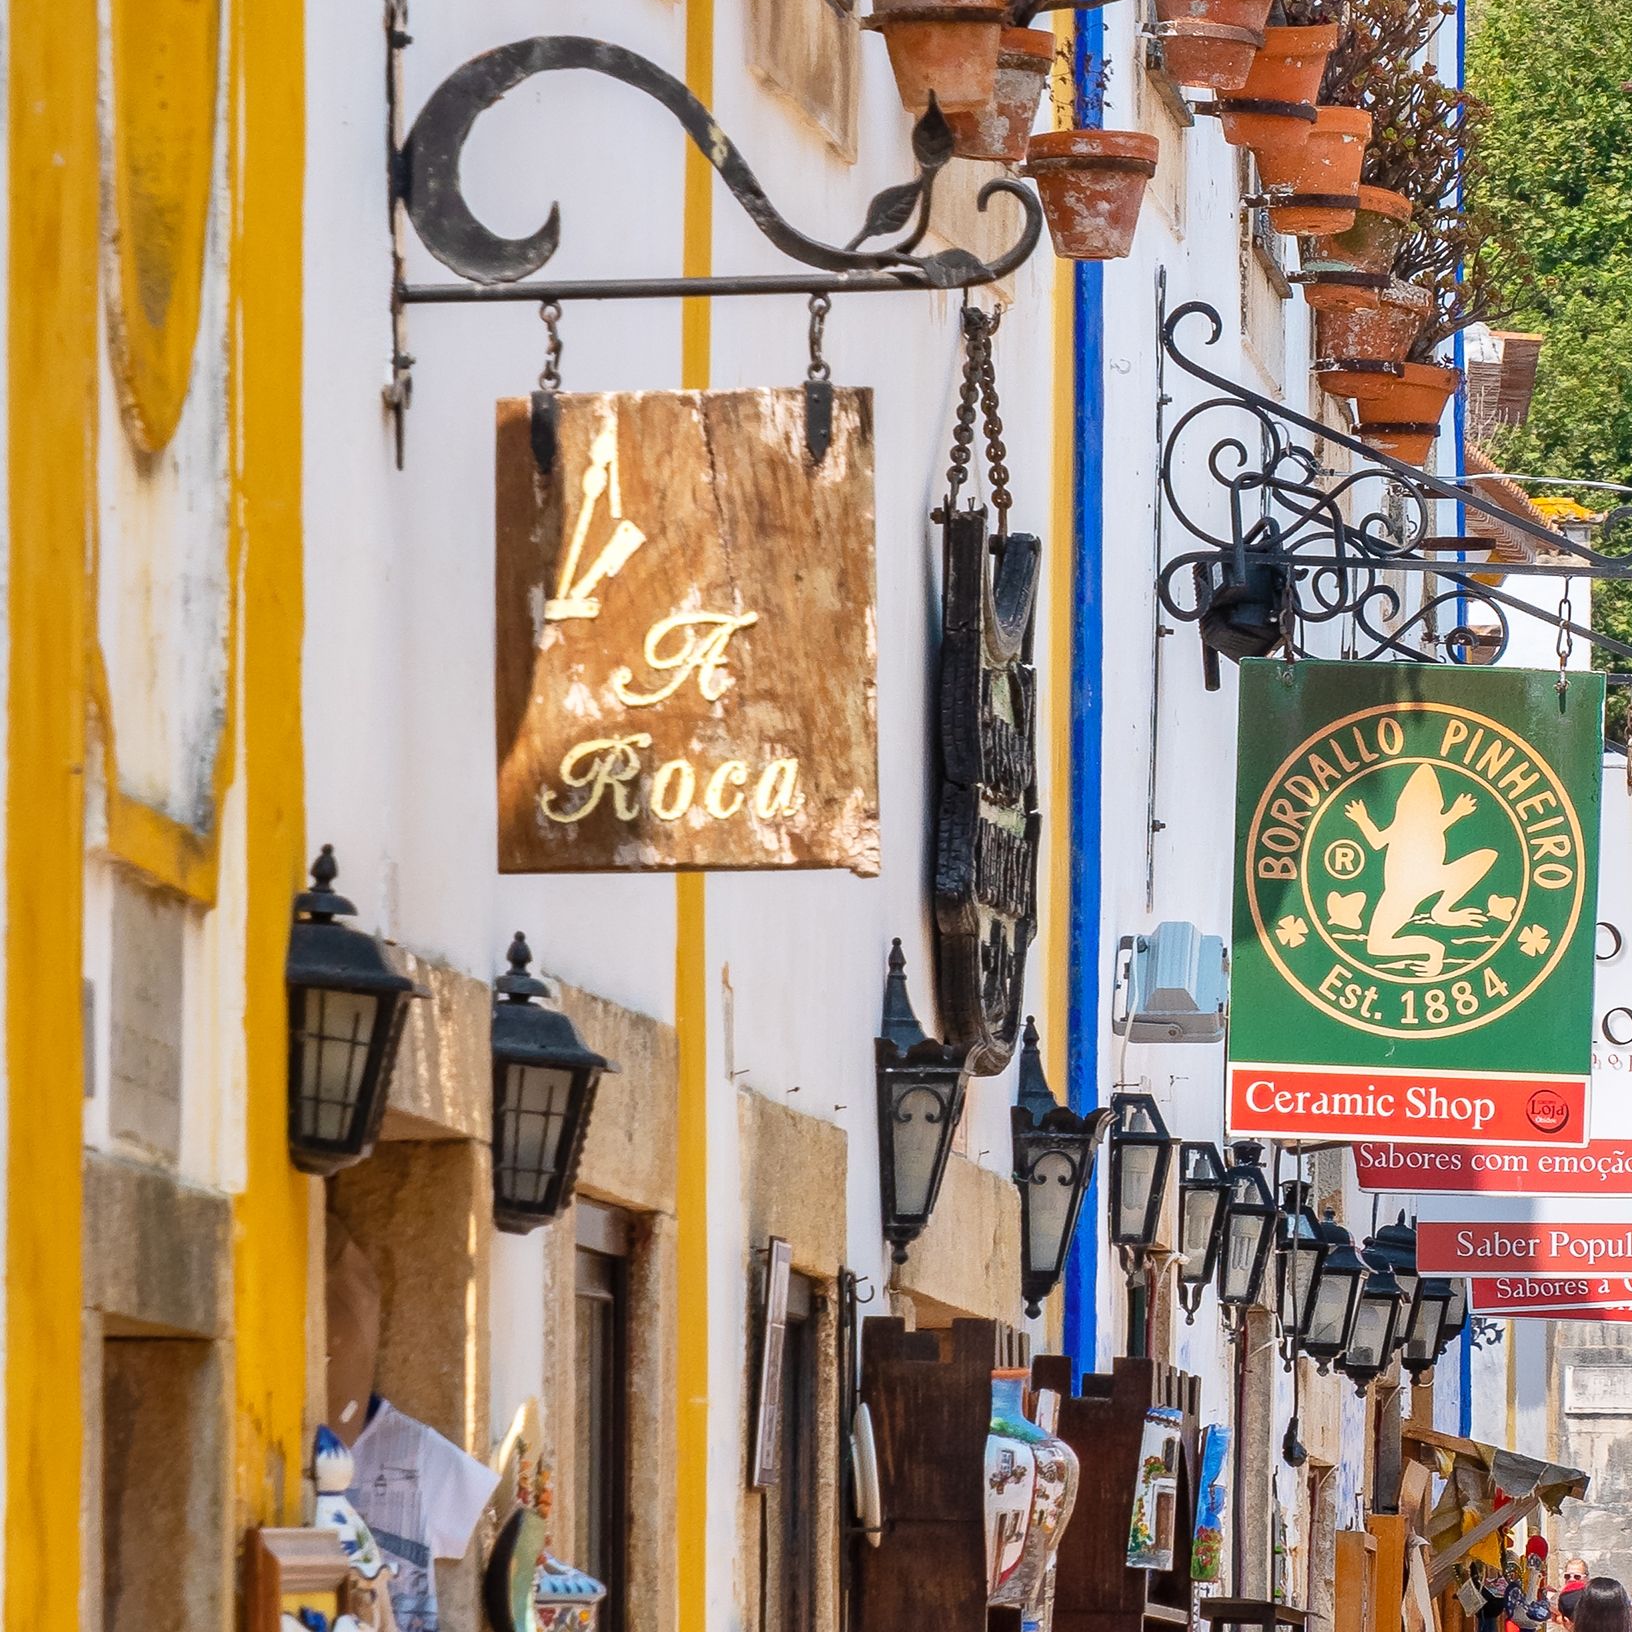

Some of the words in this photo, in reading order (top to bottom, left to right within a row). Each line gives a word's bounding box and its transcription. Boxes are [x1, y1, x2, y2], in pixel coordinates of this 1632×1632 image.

[613, 611, 759, 707] A
[542, 732, 805, 823] Roca
[1257, 716, 1405, 880] BORDALLO
[1439, 718, 1574, 890] PINHEIRO
[1318, 963, 1384, 1021] Est.
[1399, 966, 1510, 1025] 1884
[1245, 1080, 1395, 1118] Ceramic
[1404, 1086, 1496, 1131] Shop
[1359, 1142, 1463, 1170] Sabores
[1470, 1152, 1529, 1173] com
[1455, 1229, 1541, 1258] Saber
[1496, 1277, 1589, 1300] Sabores
